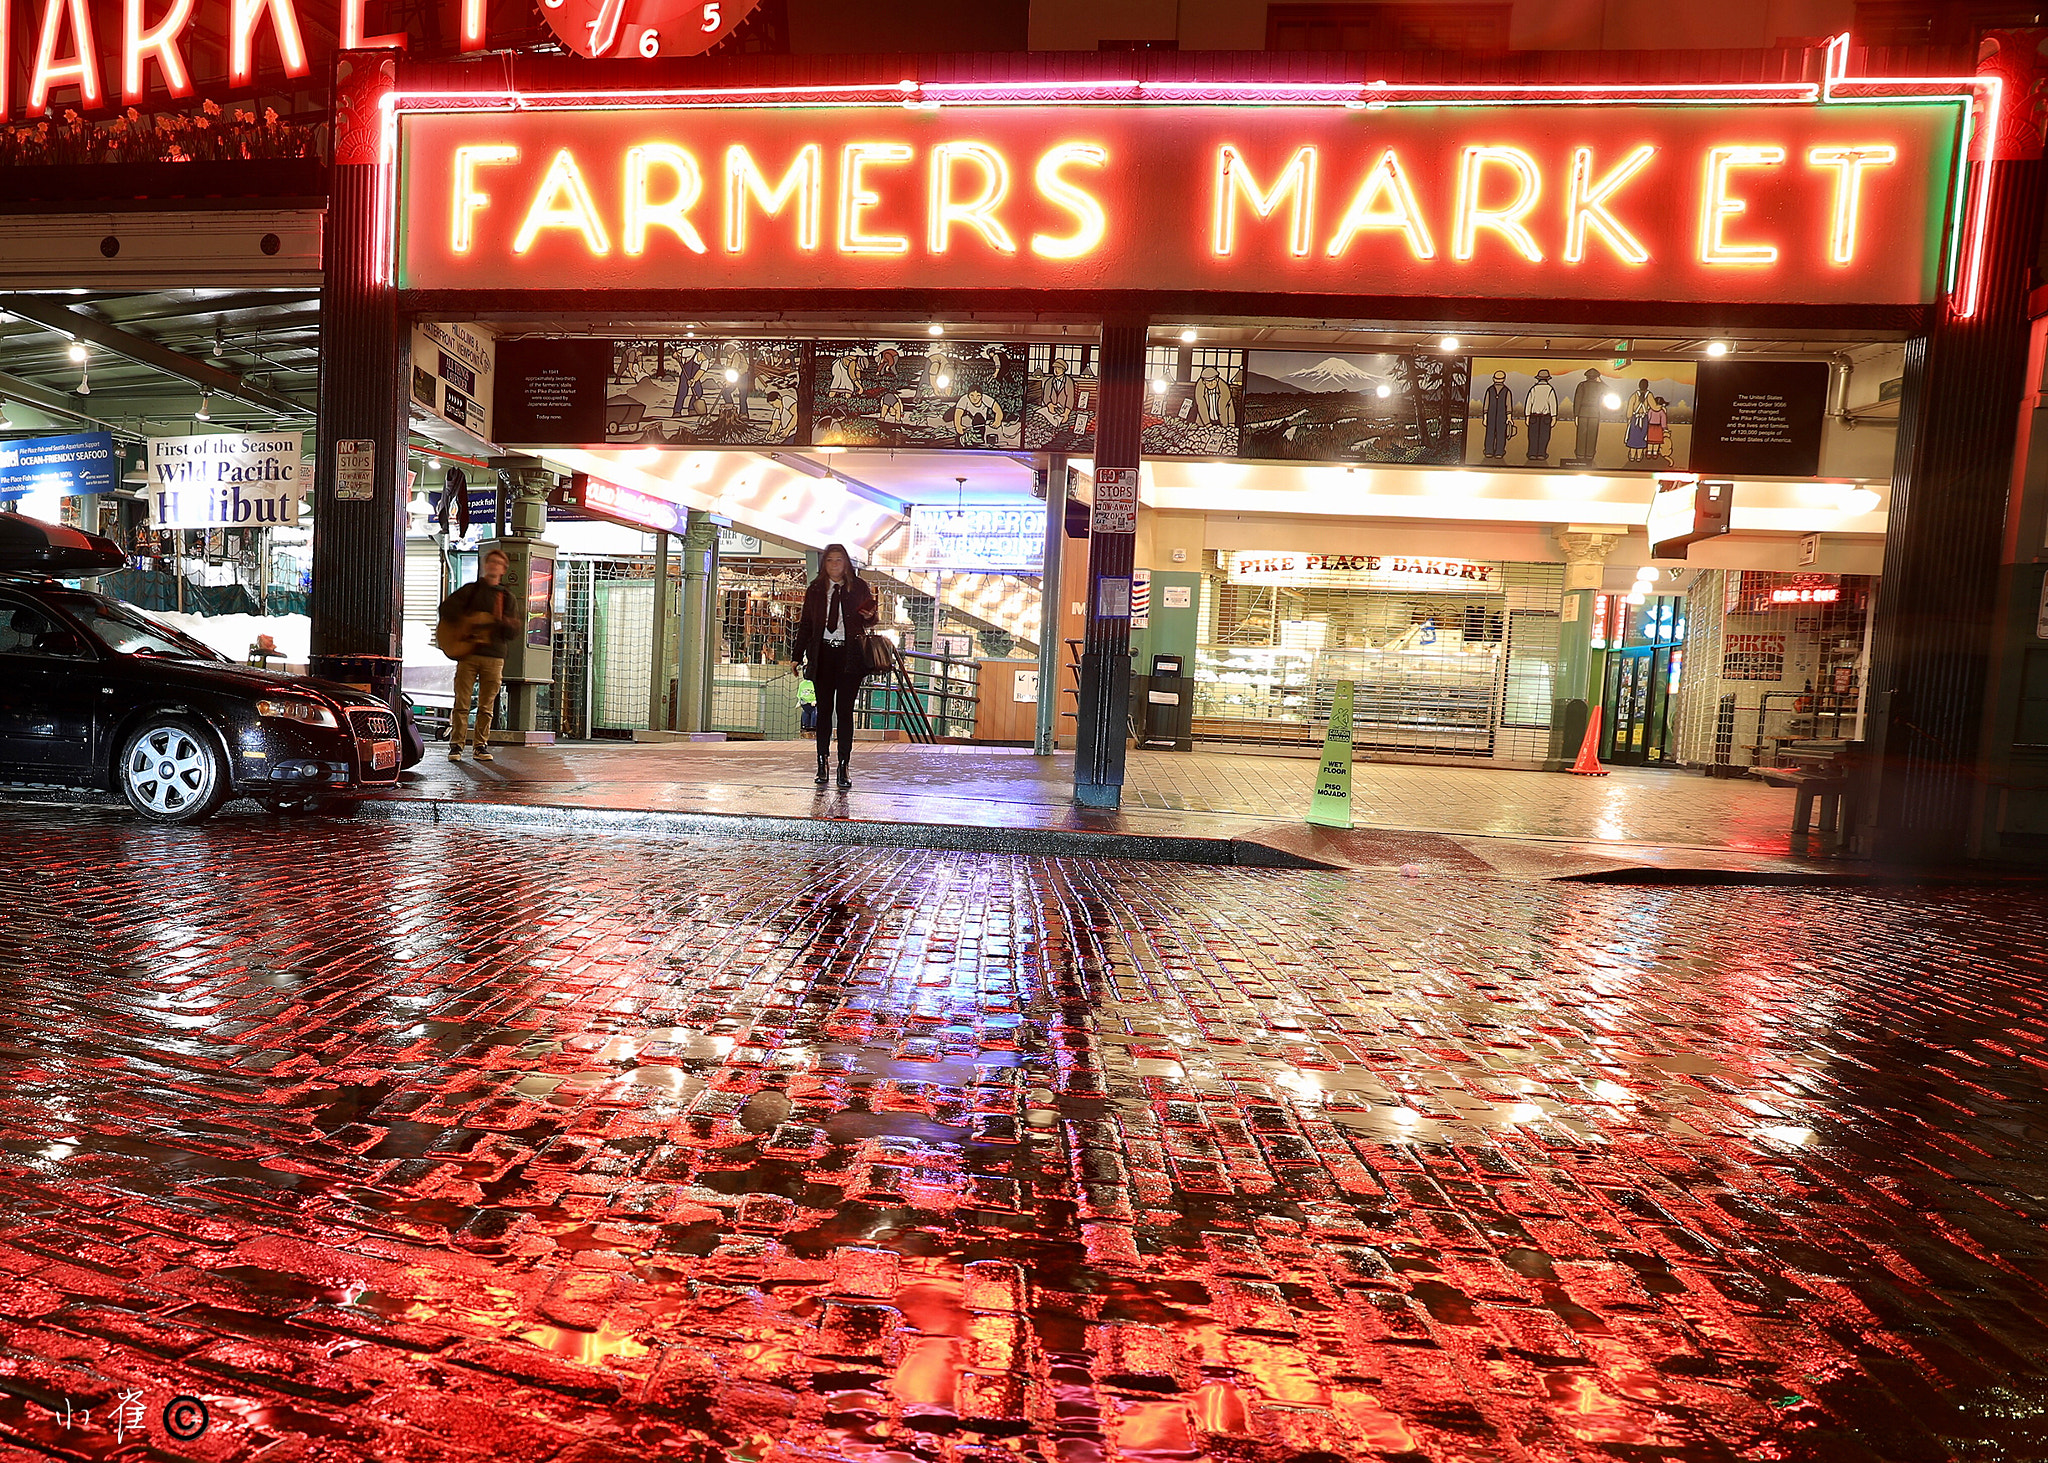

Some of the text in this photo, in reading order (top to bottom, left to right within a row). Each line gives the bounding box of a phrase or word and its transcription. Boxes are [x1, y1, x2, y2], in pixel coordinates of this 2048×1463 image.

[700, 2, 721, 32] 5
[638, 28, 660, 58] 6
[452, 142, 1897, 266] FARMERS MARKET
[155, 438, 293, 456] First of the Season
[340, 441, 354, 453] NO
[76, 450, 108, 460] SEAFOOD
[340, 456, 370, 467] STOPS
[155, 460, 206, 484] Wild
[217, 457, 292, 482] Pacific
[1100, 486, 1132, 498] STOPS
[157, 486, 290, 524] Hlibut
[484, 498, 494, 506] fish
[1240, 557, 1294, 574] PIKE
[1306, 555, 1381, 570] PLACE
[1392, 558, 1494, 581] BAKERY
[1328, 760, 1344, 768] WET
[1323, 767, 1347, 776] FLOOR
[1317, 788, 1347, 798] MOJADO
[1324, 783, 1341, 791] PISO
